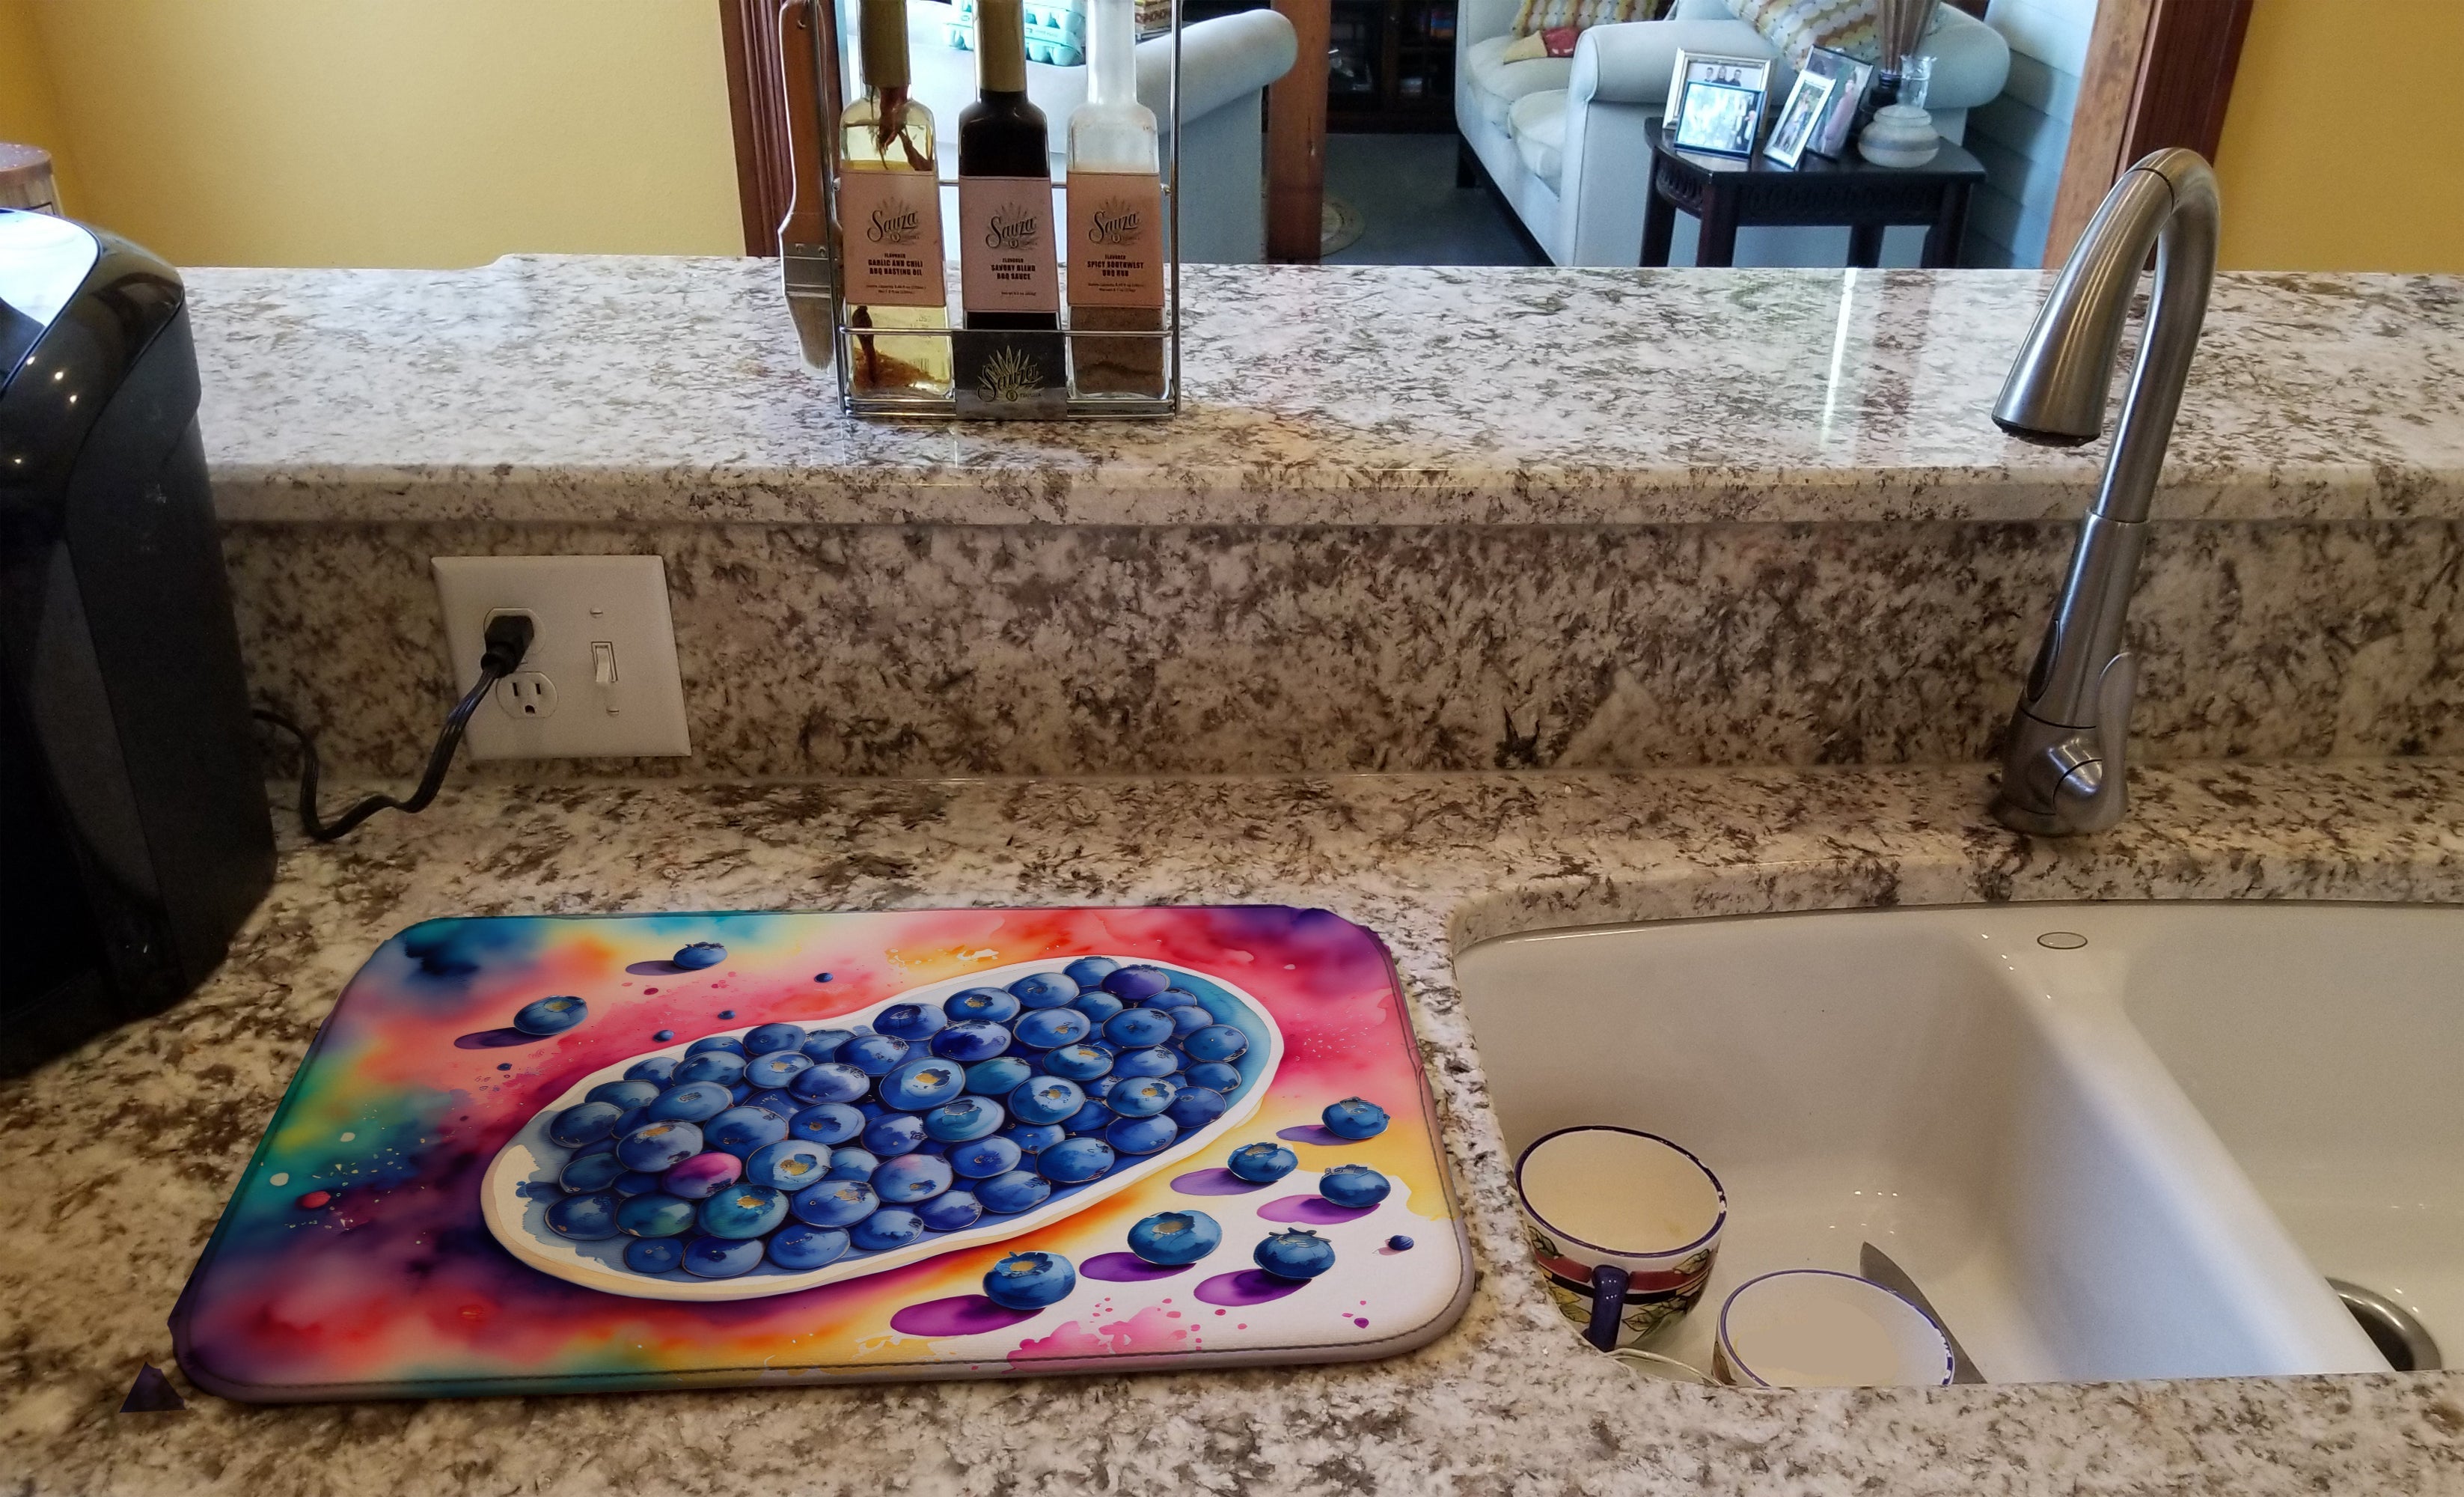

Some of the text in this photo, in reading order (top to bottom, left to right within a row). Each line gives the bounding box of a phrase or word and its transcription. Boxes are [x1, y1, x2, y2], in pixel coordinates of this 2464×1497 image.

[867, 210, 918, 243] Sauza
[985, 216, 1037, 249] Sauza
[1089, 210, 1140, 243] Sauza
[977, 364, 1039, 402] Sauza
